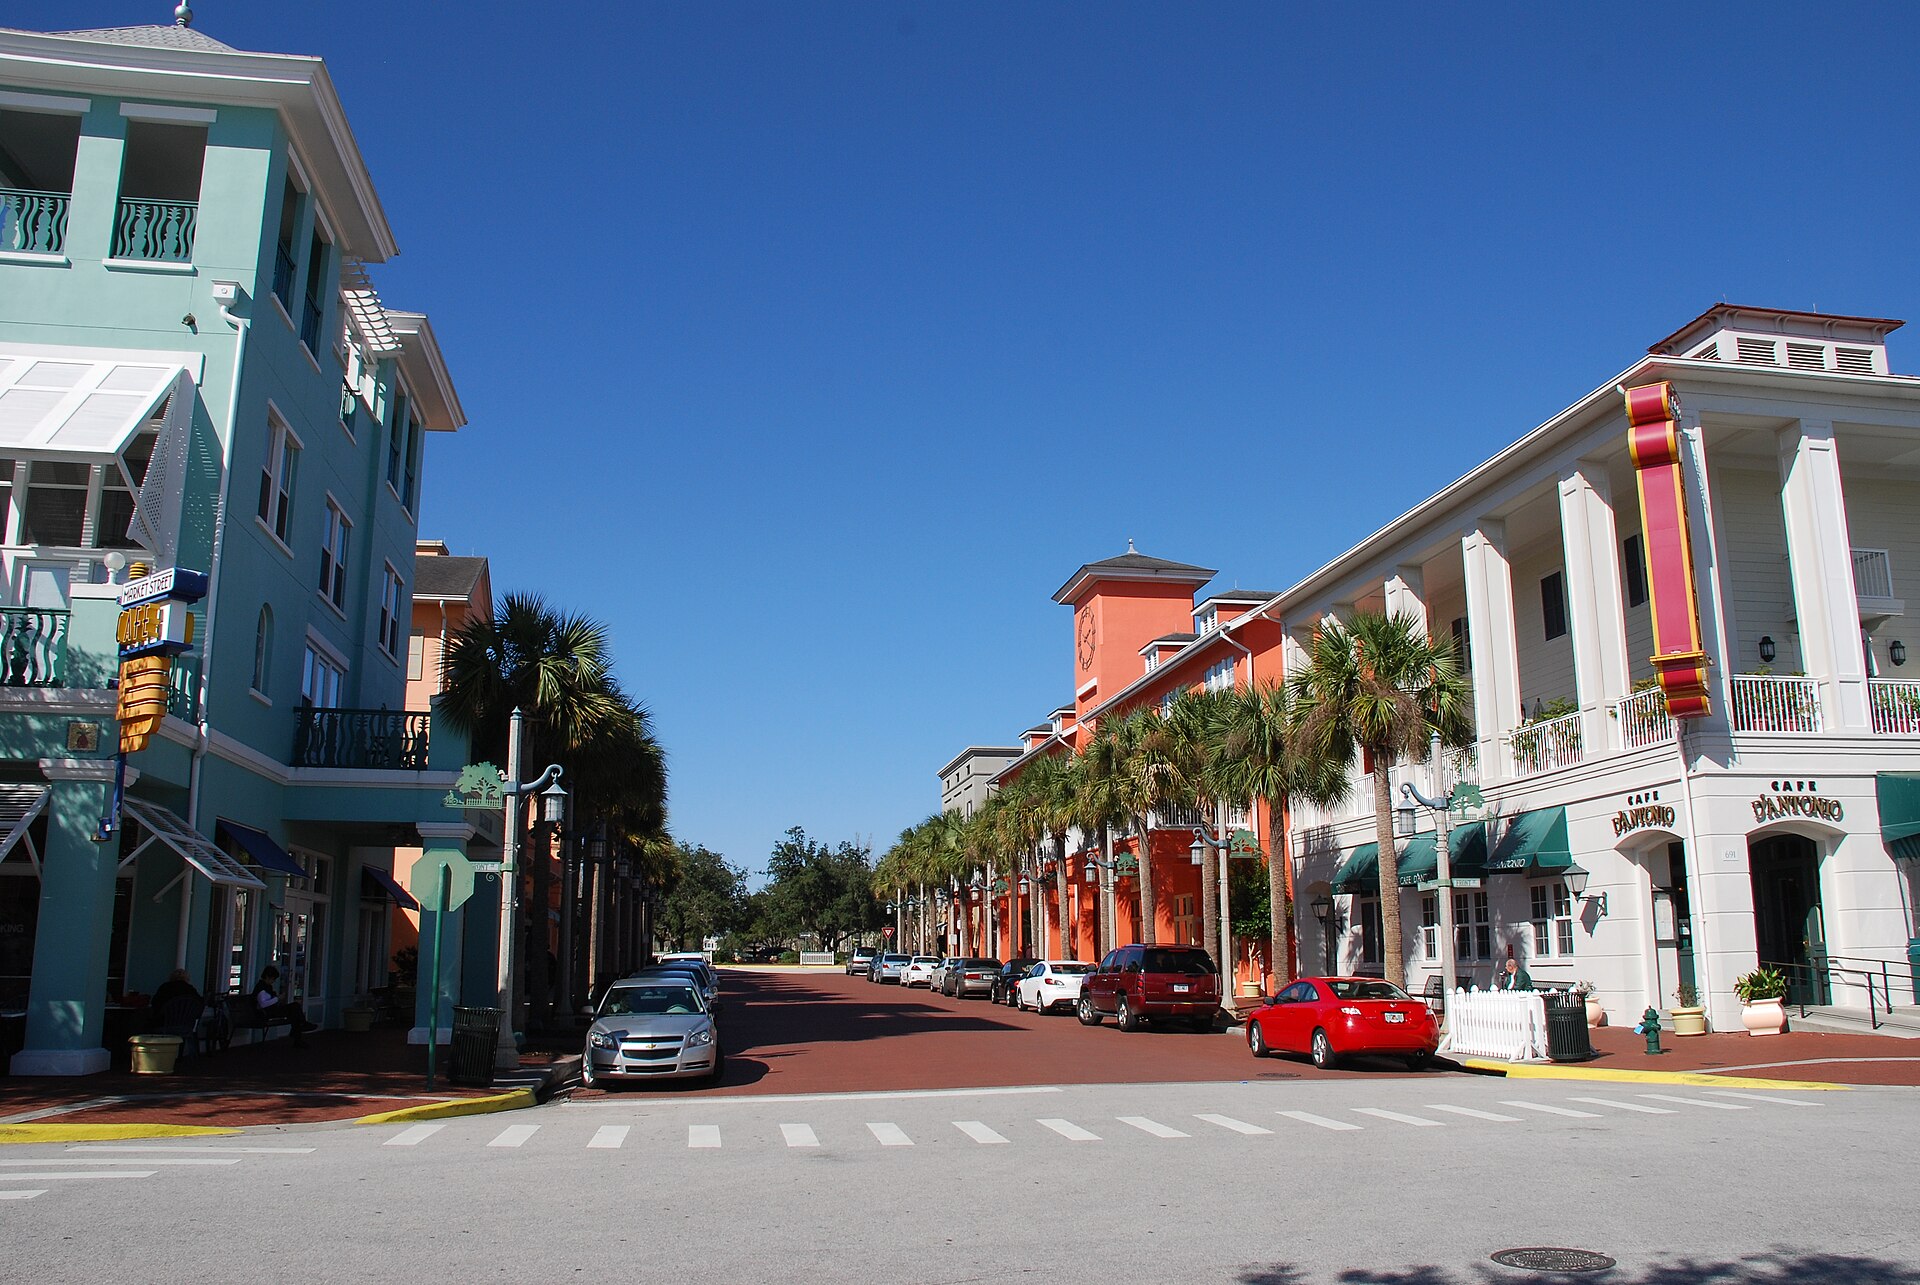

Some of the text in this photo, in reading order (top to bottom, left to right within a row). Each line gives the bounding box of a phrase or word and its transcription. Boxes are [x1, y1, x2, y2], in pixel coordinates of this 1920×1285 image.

[124, 574, 173, 603] MARKET STREET
[116, 602, 151, 643] CAFE
[1627, 790, 1659, 806] CAFE
[1770, 780, 1817, 792] CAFE
[1611, 805, 1675, 837] D'ANTONIO
[1751, 793, 1844, 823] D'ANTONIO
[1725, 850, 1736, 859] 691
